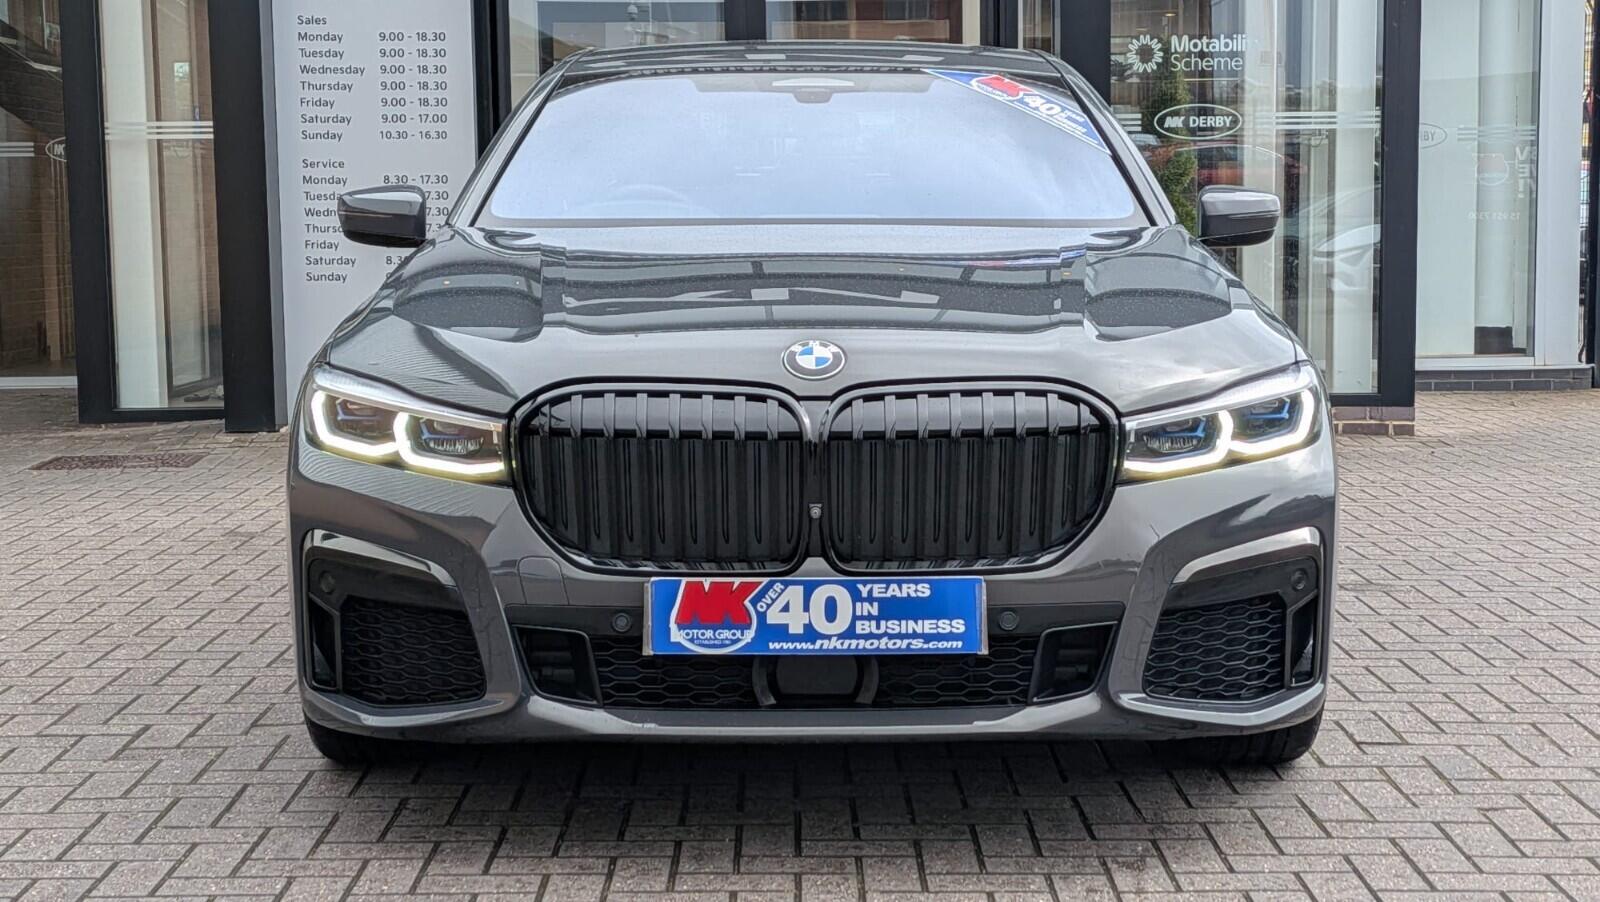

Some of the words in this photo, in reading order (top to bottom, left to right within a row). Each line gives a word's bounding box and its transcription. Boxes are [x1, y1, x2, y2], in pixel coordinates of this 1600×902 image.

[297, 15, 327, 25] Sales
[298, 32, 343, 43] Monday
[378, 32, 404, 42] 9.00
[415, 32, 446, 42] 18.30
[1171, 34, 1248, 52] Motabili
[299, 48, 345, 60] Tuesday
[379, 48, 405, 58] 9.00
[416, 48, 447, 58] 18.30
[1171, 54, 1243, 71] Scheme
[299, 64, 365, 76] Wednesday
[379, 65, 405, 75] 9.00
[416, 65, 447, 75] 18.30
[300, 81, 353, 93] Thursday
[380, 81, 406, 91] 9.00
[417, 81, 448, 91] 18.30
[300, 97, 335, 109] Friday
[380, 97, 406, 107] 9.00
[418, 97, 448, 107] 18.30
[1024, 95, 1059, 115] 40
[300, 113, 352, 126] Saturday
[381, 113, 407, 124] 9.00
[418, 113, 448, 124] 17.00
[1189, 116, 1233, 128] DERBY
[301, 130, 343, 142] Sunday
[379, 130, 408, 140] 10.30
[419, 130, 448, 140] 16.30
[302, 159, 345, 169] Service
[302, 175, 348, 187] Monday
[383, 175, 409, 184] 8.30
[419, 175, 448, 184] 17.30
[304, 191, 342, 201] Tuesda
[425, 191, 449, 200] 7.30
[425, 207, 449, 216] 7.30
[305, 224, 343, 233] Thurs
[305, 240, 339, 251] Friday
[305, 256, 356, 267] Saturday
[306, 271, 348, 284] Sunday
[856, 584, 931, 597] YEARS
[756, 582, 784, 612] OVER
[766, 584, 853, 635] 40
[856, 602, 878, 616] IN
[856, 619, 965, 634] BUSINESS
[768, 636, 963, 650] www.nkmotors.com
